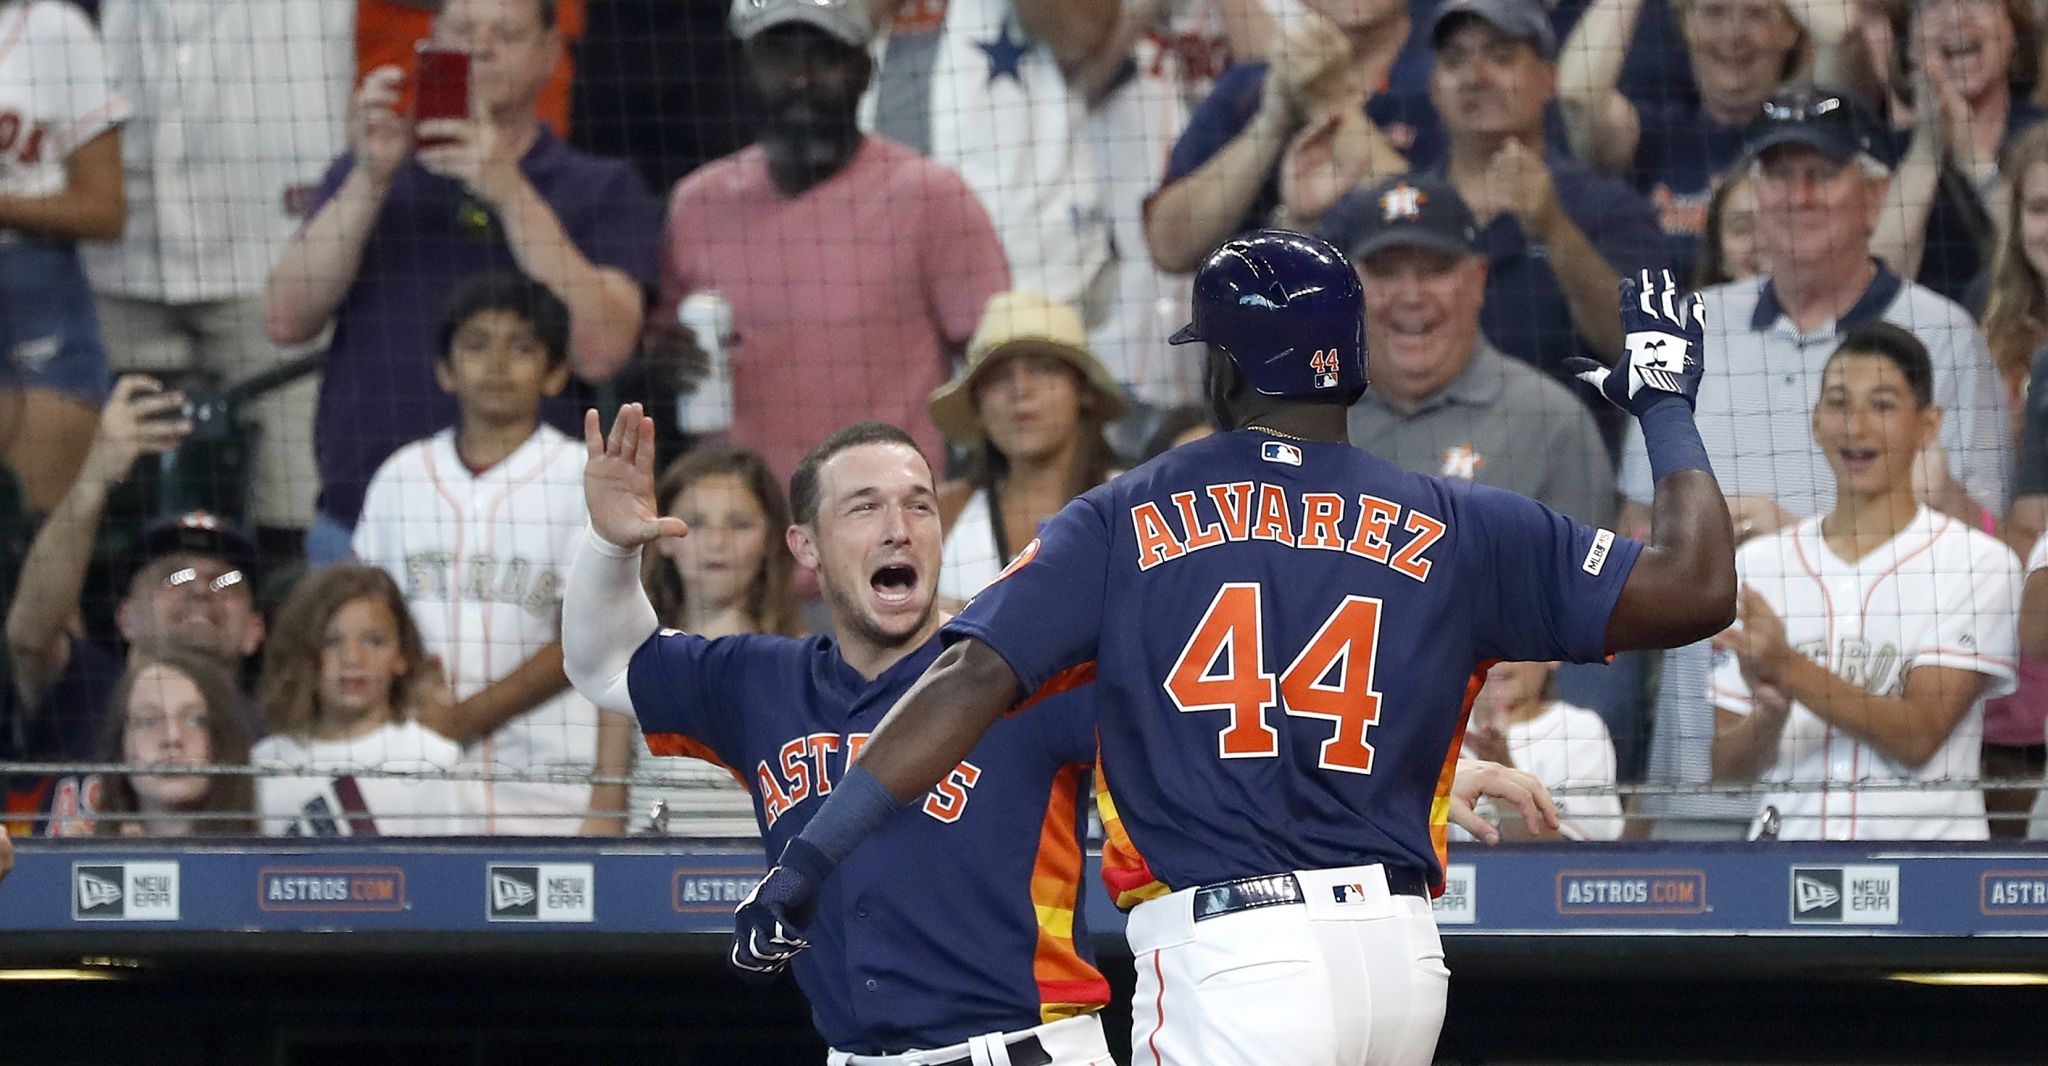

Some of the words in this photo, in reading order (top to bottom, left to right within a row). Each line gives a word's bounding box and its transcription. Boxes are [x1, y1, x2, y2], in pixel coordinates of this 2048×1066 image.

[1310, 348, 1339, 373] 44
[1131, 480, 1447, 583] ALVAREZ
[1163, 581, 1384, 775] 44
[1852, 880, 1891, 896] NEW
[1992, 881, 2048, 904] ASTR
[1852, 896, 1891, 912] ERA
